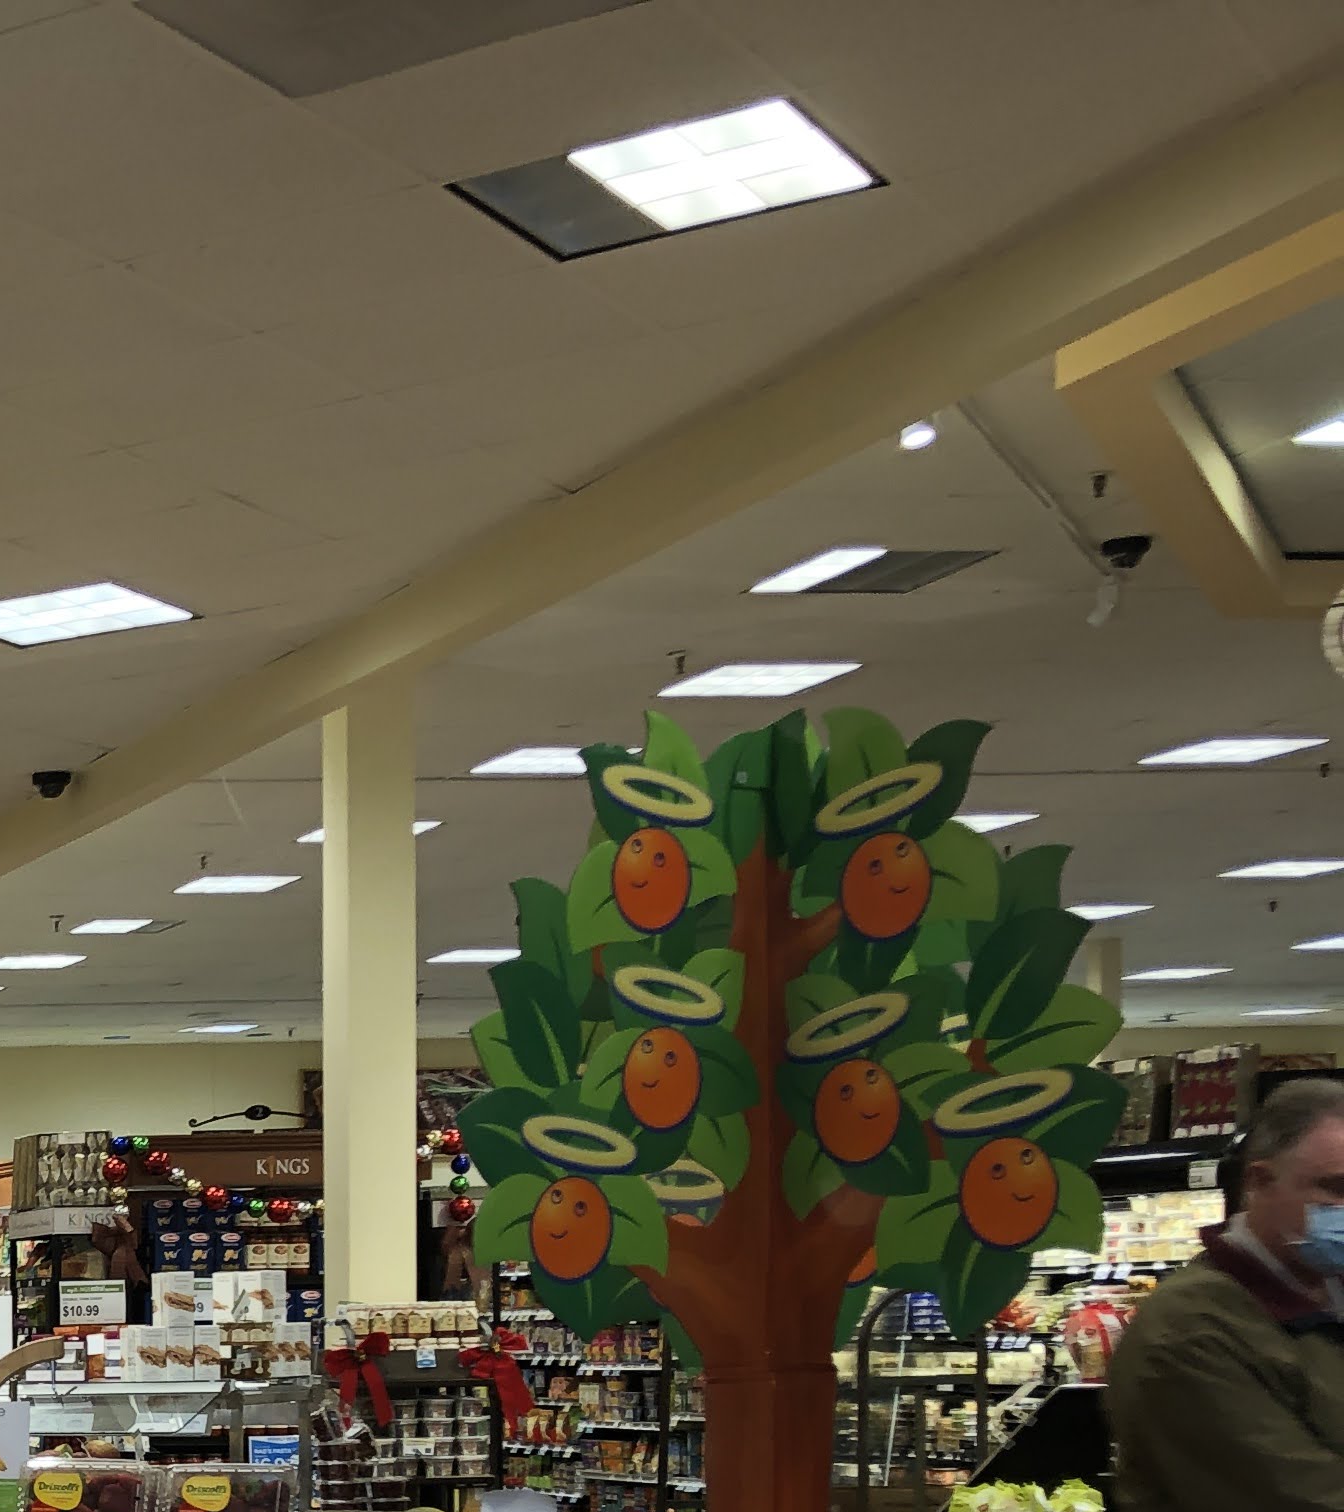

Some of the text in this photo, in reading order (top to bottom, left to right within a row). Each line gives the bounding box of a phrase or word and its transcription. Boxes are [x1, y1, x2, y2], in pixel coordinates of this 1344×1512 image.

[256, 1156, 310, 1179] KINGS
[62, 1304, 100, 1318] $10.99
[37, 1481, 81, 1493] Driscoll's
[185, 1483, 228, 1495] Driscoll's
